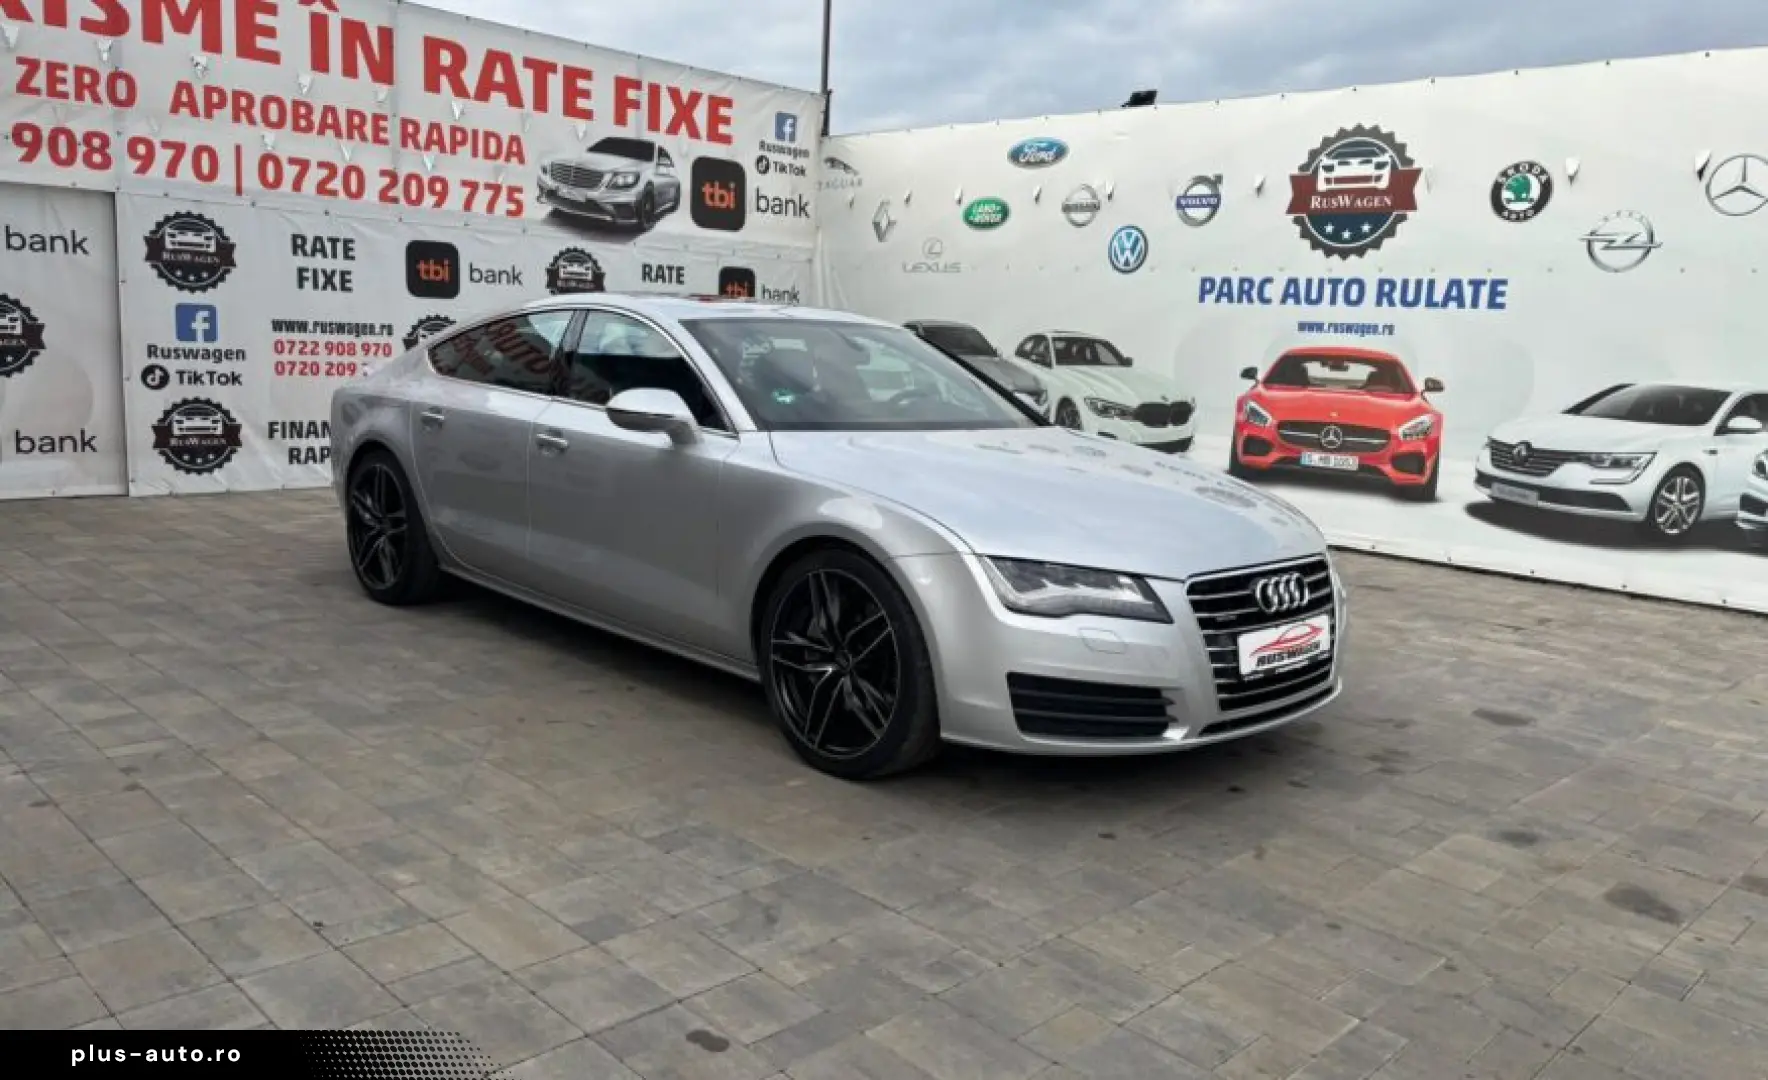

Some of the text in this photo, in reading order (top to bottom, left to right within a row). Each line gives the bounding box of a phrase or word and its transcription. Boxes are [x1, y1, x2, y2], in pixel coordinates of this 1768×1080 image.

[422, 35, 595, 122] RATE
[613, 75, 734, 145] FIXE
[15, 56, 526, 165] ZERO APROBARE RAPIDA
[758, 139, 810, 160] Ruswagen
[11, 122, 113, 171] 908
[126, 136, 220, 183] 970
[257, 152, 367, 200] 0720
[378, 169, 448, 208] 209
[459, 180, 525, 217] 775
[772, 160, 807, 177] TikTok
[702, 182, 736, 209] tbi
[756, 187, 811, 219] bank
[5, 225, 90, 256] bank
[291, 233, 356, 261] RATE
[416, 259, 450, 282] tbi
[469, 262, 524, 286] bank
[641, 263, 685, 285] RATE
[901, 261, 962, 274] LEXUS
[296, 266, 354, 293] FIXE
[1198, 276, 1509, 310] PARC AUTO RULATE
[271, 319, 394, 337] www.ruswagen.ro
[1296, 320, 1395, 338] www.ruswagen.ro
[147, 344, 247, 364] Ruswagen
[274, 339, 393, 358] 0722 908 970
[176, 370, 243, 386] TikTok
[274, 360, 320, 377] 0720
[324, 361, 357, 377] 209
[15, 429, 97, 454] bank
